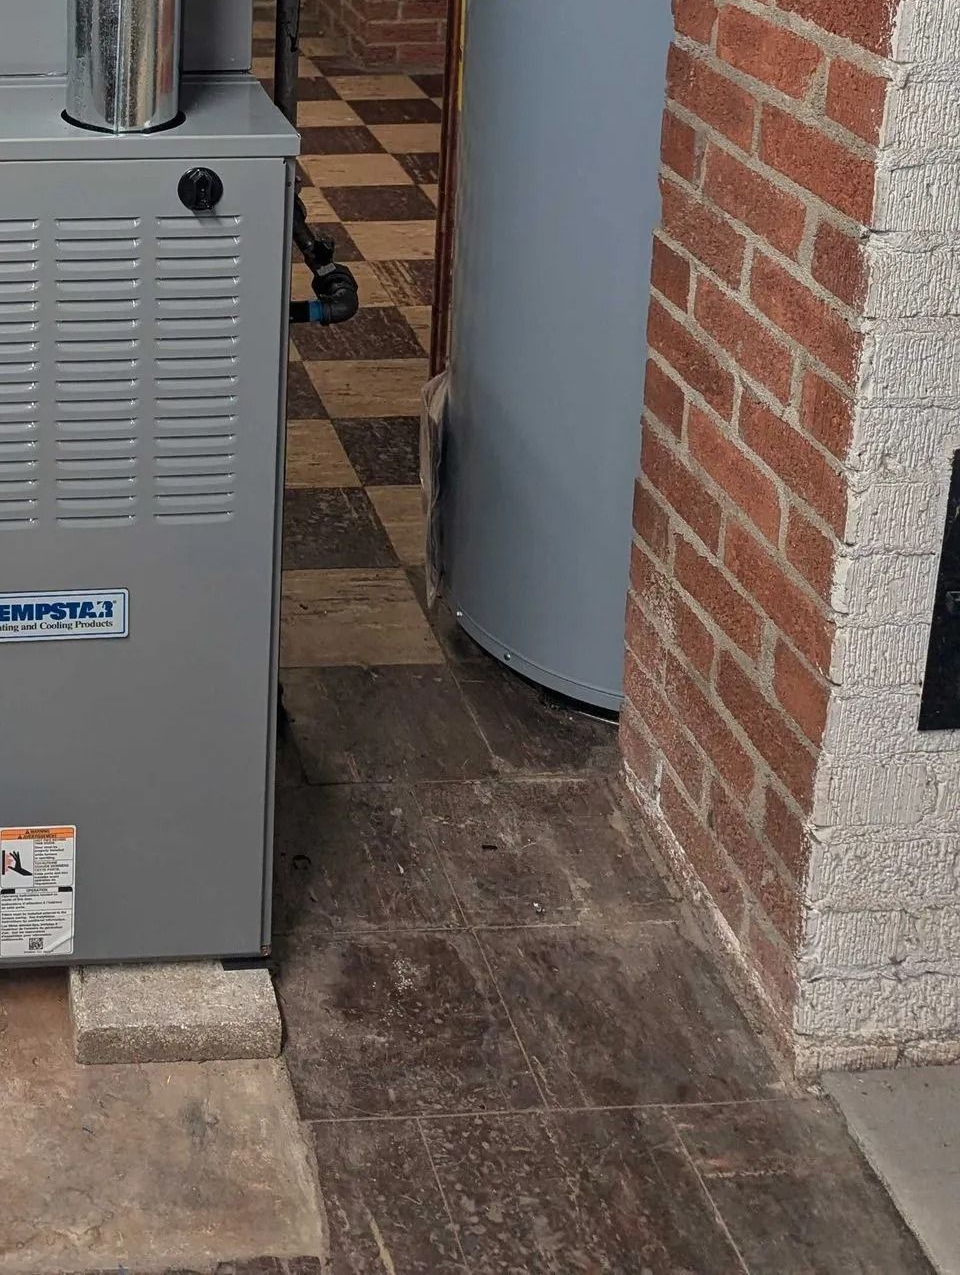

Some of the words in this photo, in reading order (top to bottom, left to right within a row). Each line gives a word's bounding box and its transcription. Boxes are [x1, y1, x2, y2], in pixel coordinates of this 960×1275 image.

[21, 622, 37, 631] and
[39, 621, 73, 631] Cooling
[75, 619, 113, 629] Products
